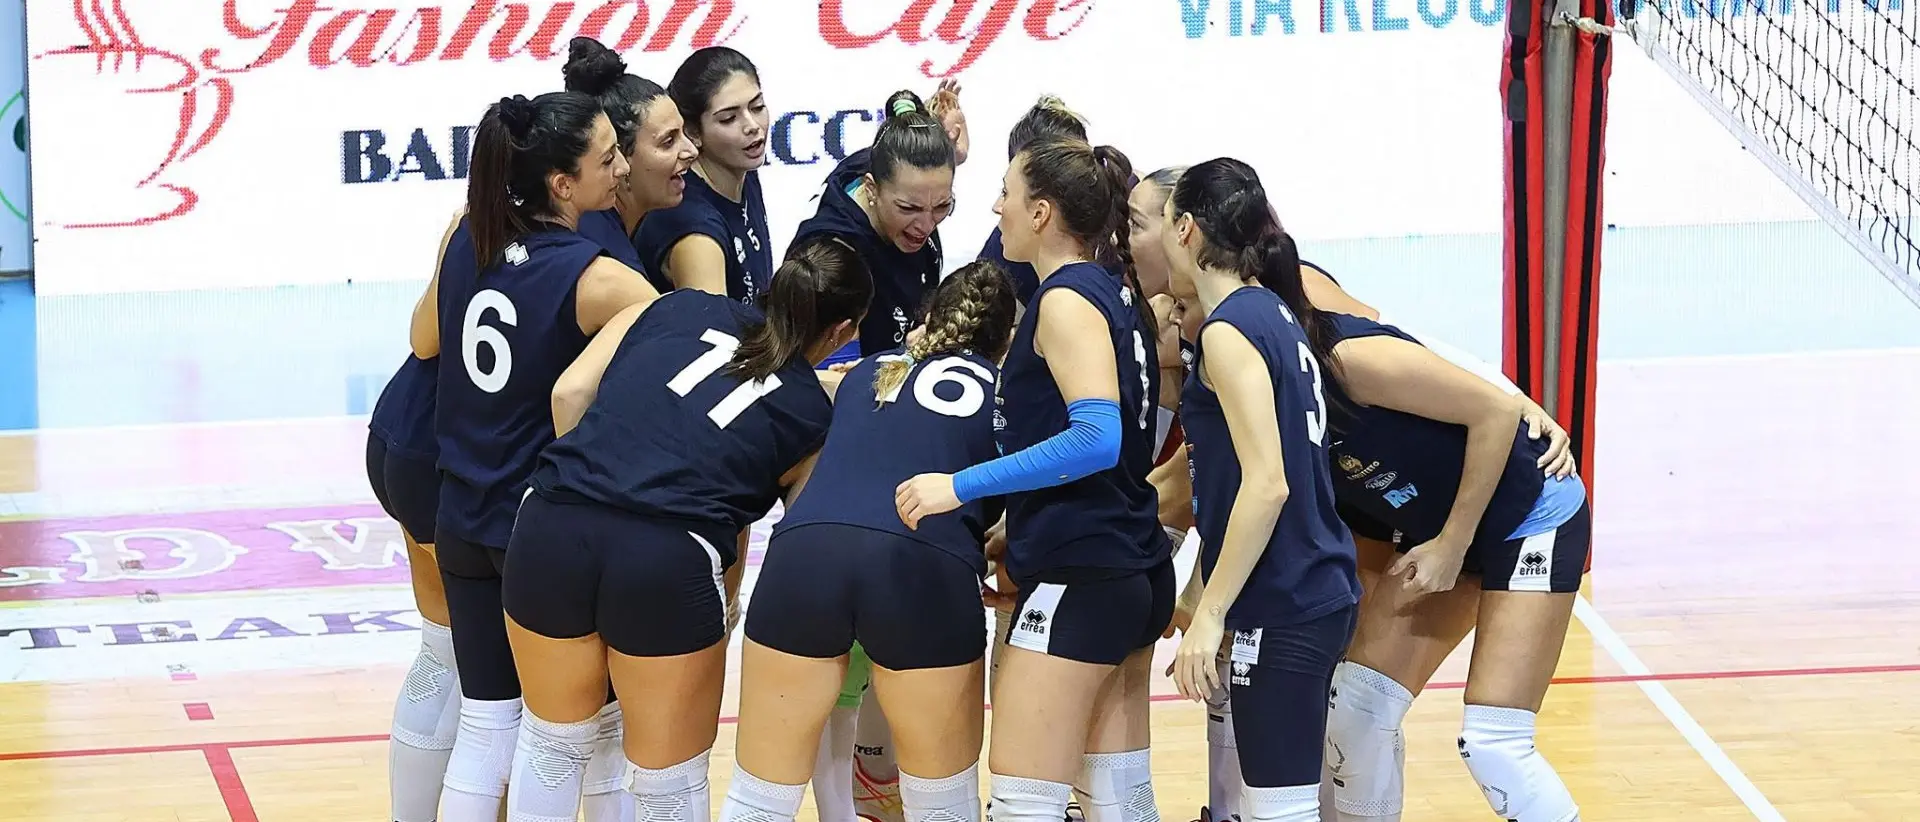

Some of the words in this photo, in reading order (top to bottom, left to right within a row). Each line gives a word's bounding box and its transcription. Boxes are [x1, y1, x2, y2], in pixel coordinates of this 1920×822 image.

[746, 228, 761, 251] 5
[462, 289, 517, 393] 6
[666, 328, 783, 430] 11
[1297, 341, 1327, 447] 3
